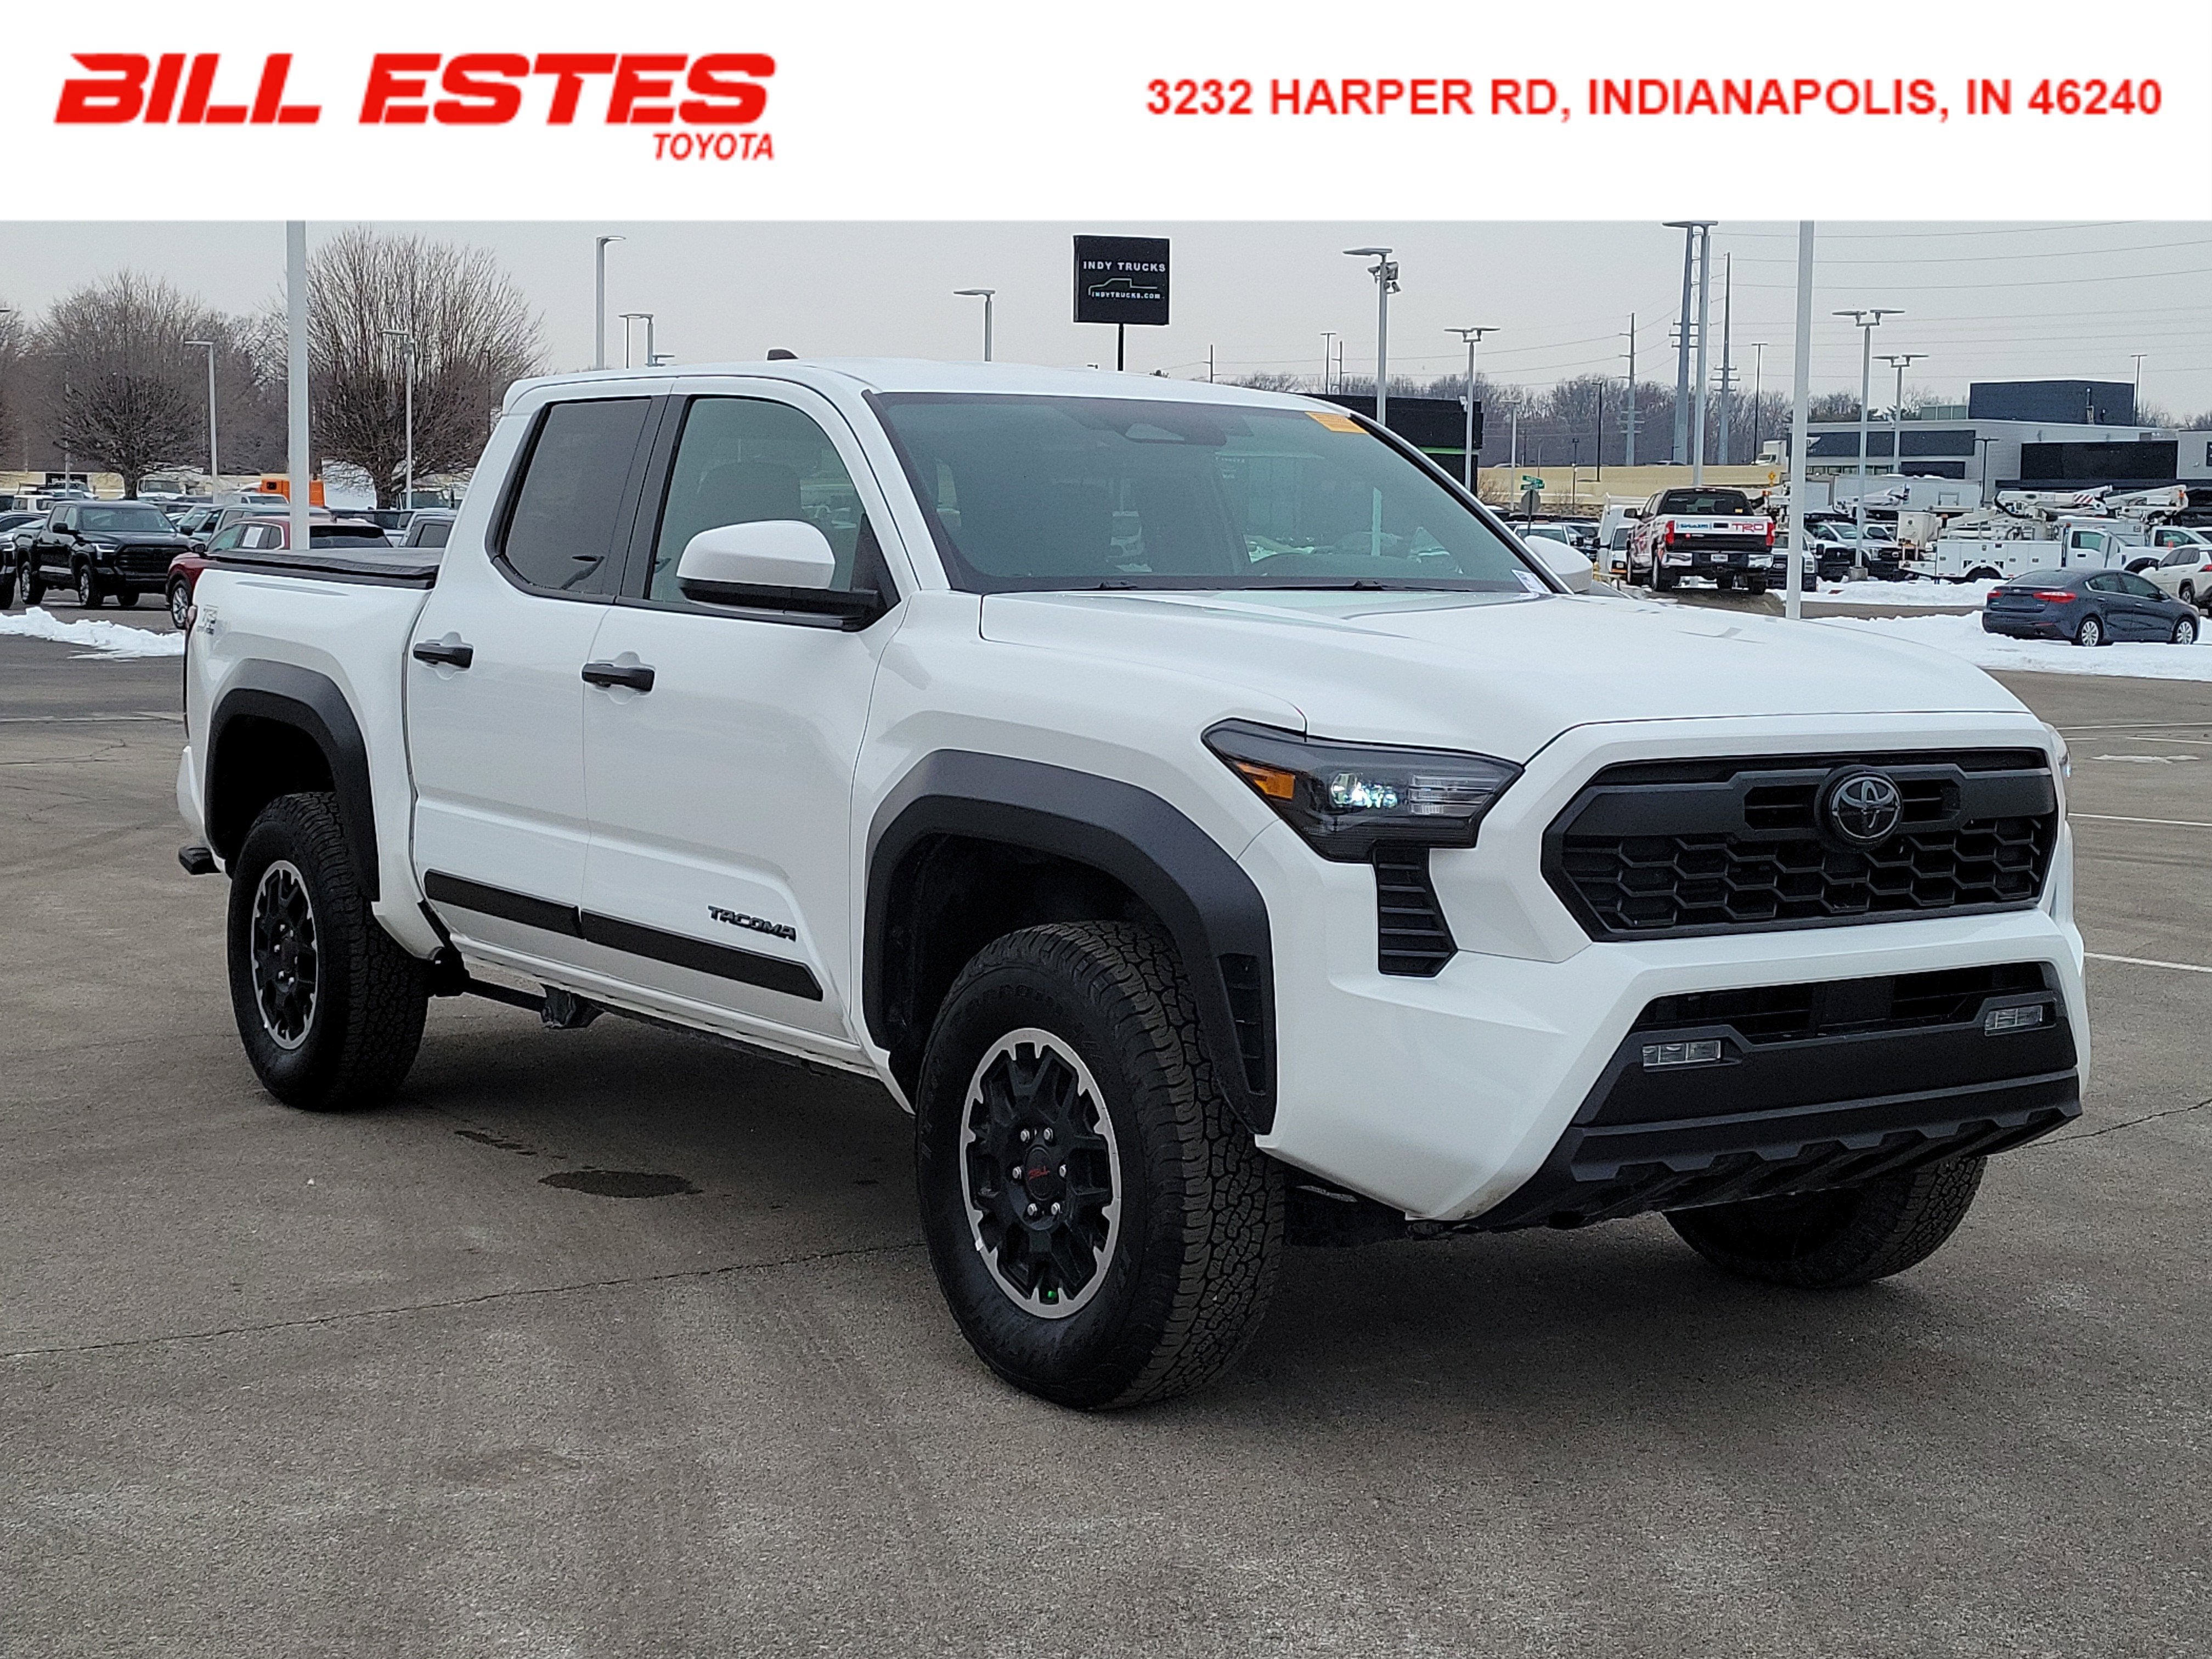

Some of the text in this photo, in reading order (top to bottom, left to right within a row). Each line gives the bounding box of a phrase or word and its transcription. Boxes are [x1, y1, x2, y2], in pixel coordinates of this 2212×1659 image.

[1083, 261, 1166, 273] INDY TRUCKS
[1092, 291, 1161, 300] INDYTRUCKS.COM
[1731, 523, 1764, 533] TRD
[708, 905, 797, 943] TACOMA
